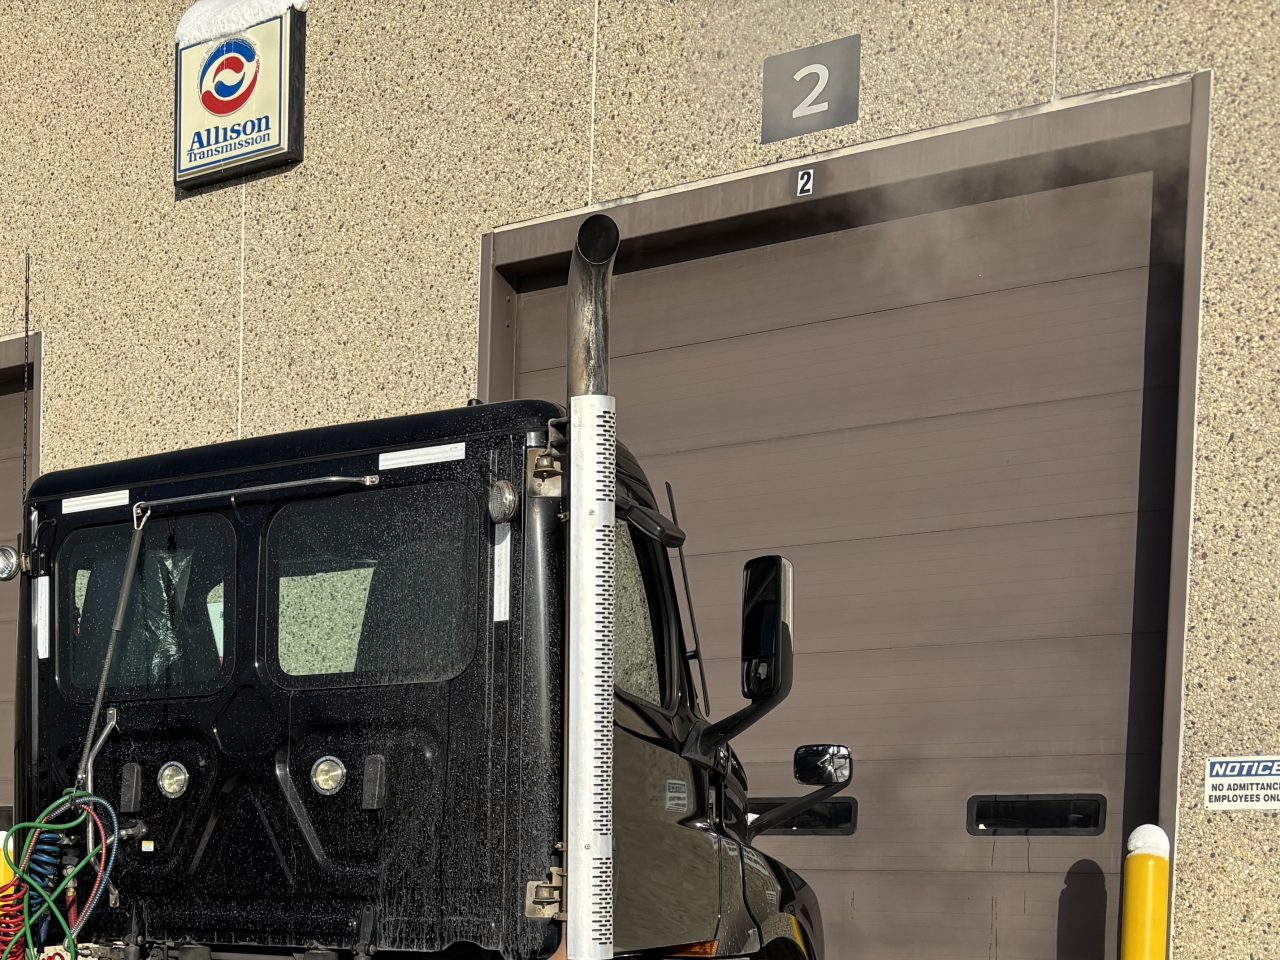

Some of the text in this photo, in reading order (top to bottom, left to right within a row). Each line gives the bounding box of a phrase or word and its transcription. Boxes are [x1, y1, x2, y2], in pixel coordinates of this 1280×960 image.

[792, 63, 830, 118] 2
[188, 115, 272, 152] Allison
[187, 132, 271, 163] Transmission
[799, 171, 812, 196] 2
[1212, 762, 1280, 776] NOTICE
[1208, 794, 1280, 802] EMPLOYEES ONL
[1212, 782, 1280, 792] NO ADMITTANC
